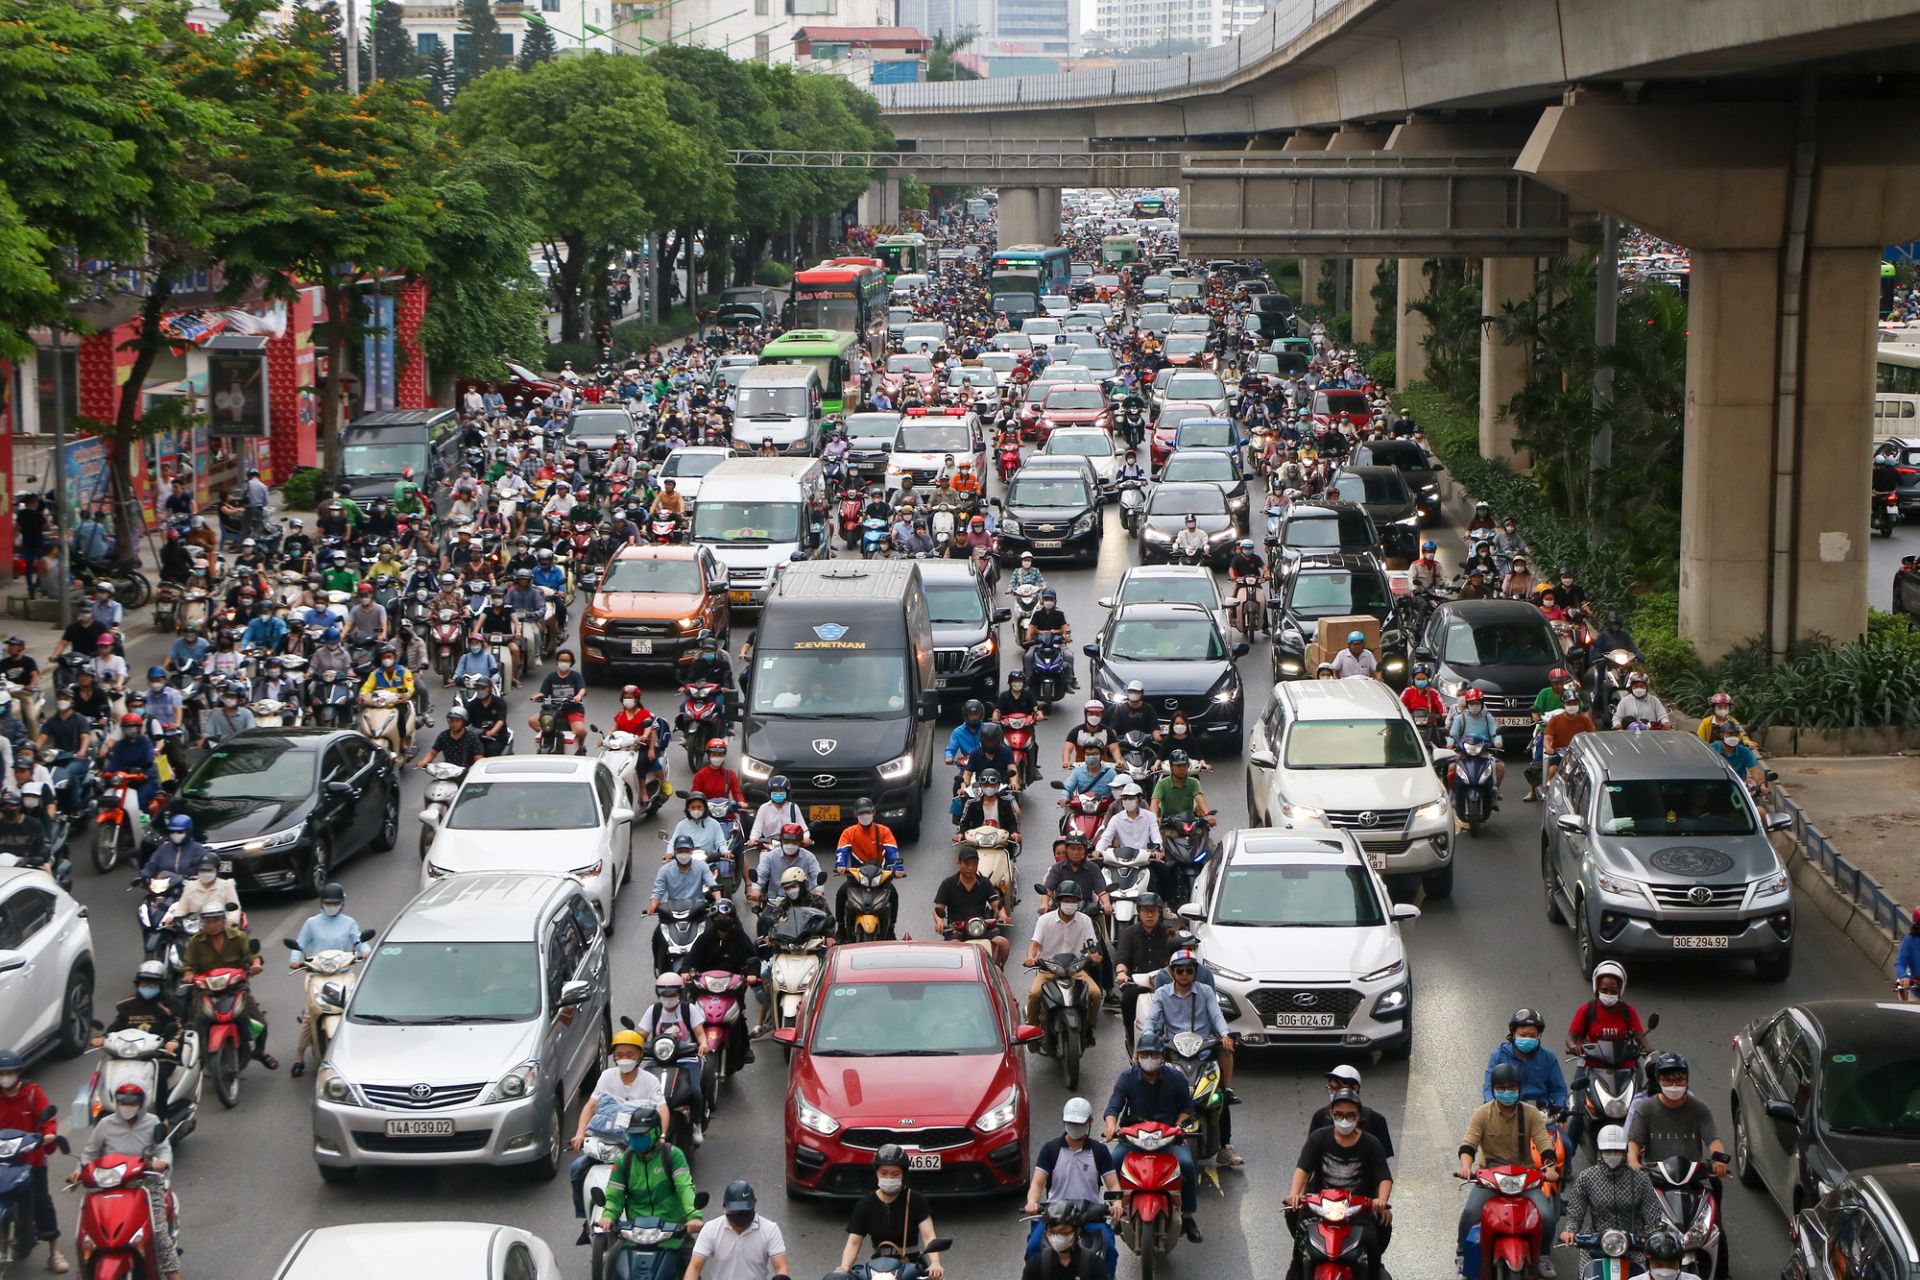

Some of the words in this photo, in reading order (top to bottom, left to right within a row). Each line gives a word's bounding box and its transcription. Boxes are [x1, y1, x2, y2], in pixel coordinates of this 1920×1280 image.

[1674, 937, 1727, 947] 30E-294.92
[1278, 1014, 1333, 1026] 30G-024.67
[389, 1121, 450, 1134] 14A-039.02
